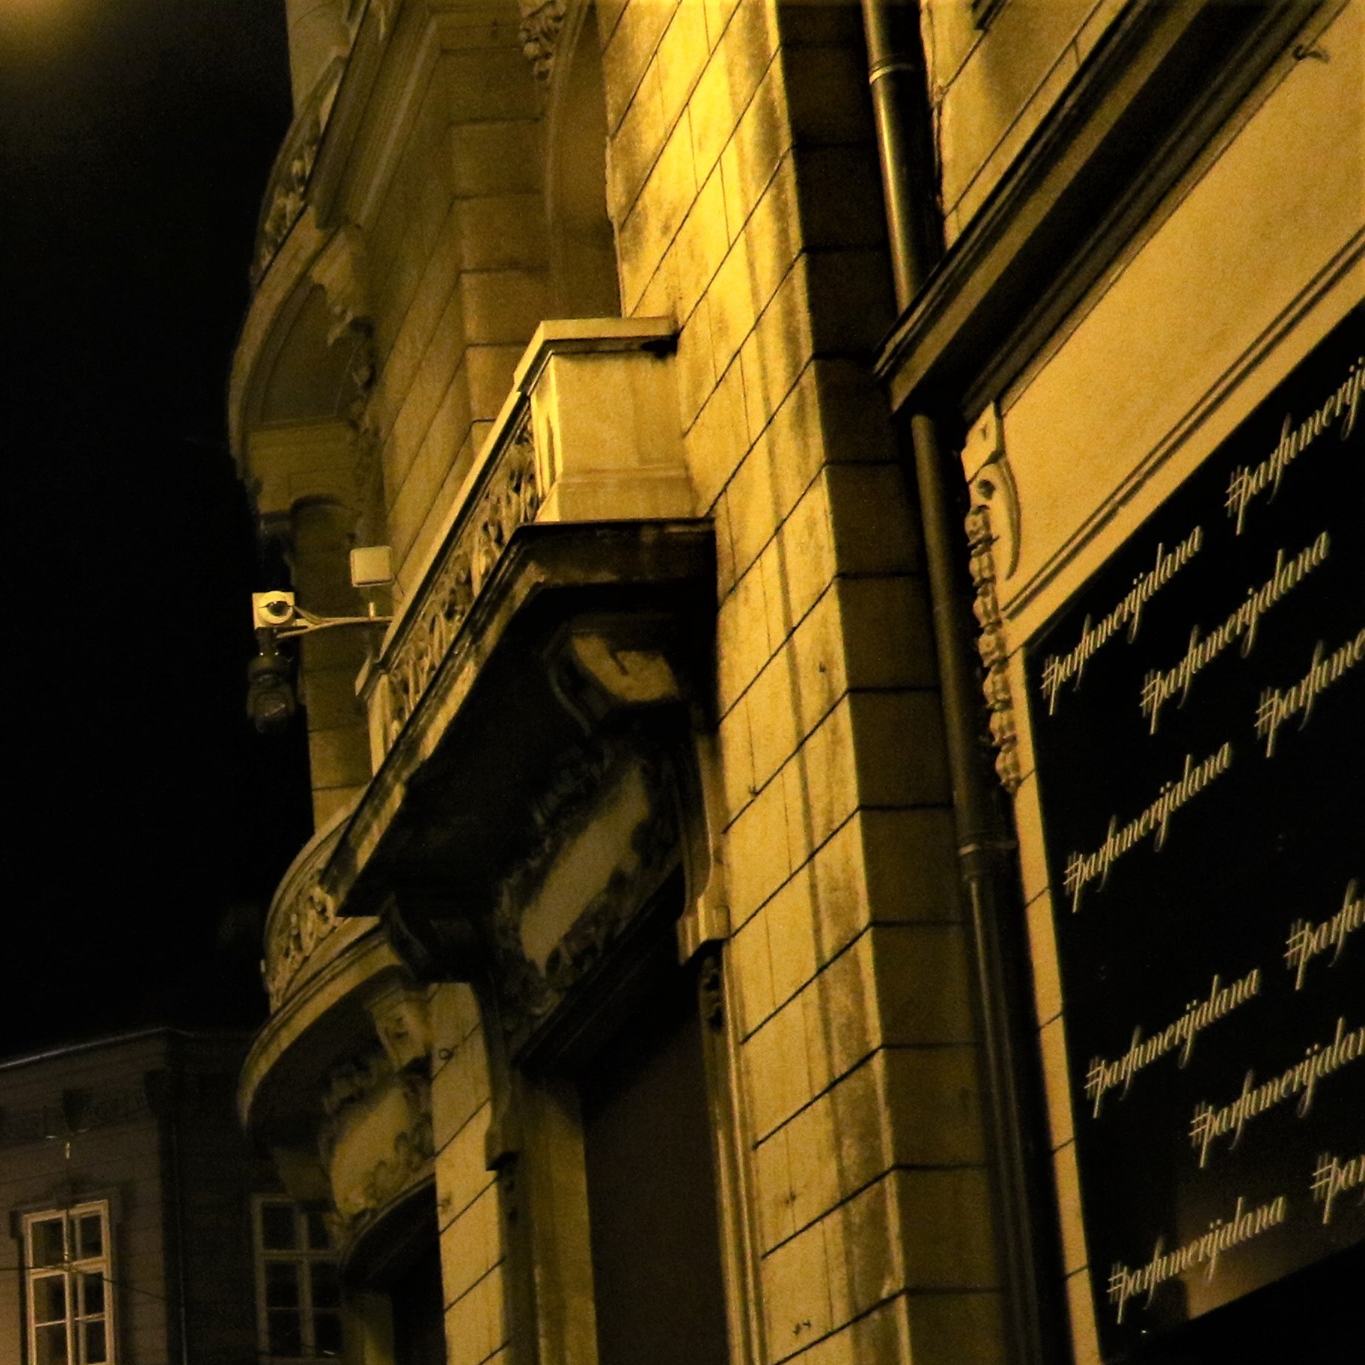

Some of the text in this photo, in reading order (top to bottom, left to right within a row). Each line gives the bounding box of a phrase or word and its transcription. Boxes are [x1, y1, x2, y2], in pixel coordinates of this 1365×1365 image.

[1041, 524, 1203, 716] #parfumerijalana
[1139, 530, 1331, 735] #parfumerijalana
[1063, 741, 1232, 913] #parfumerijalana
[1084, 968, 1261, 1119] #parfumerijalana
[1107, 1196, 1286, 1325] #parfumerijalana
